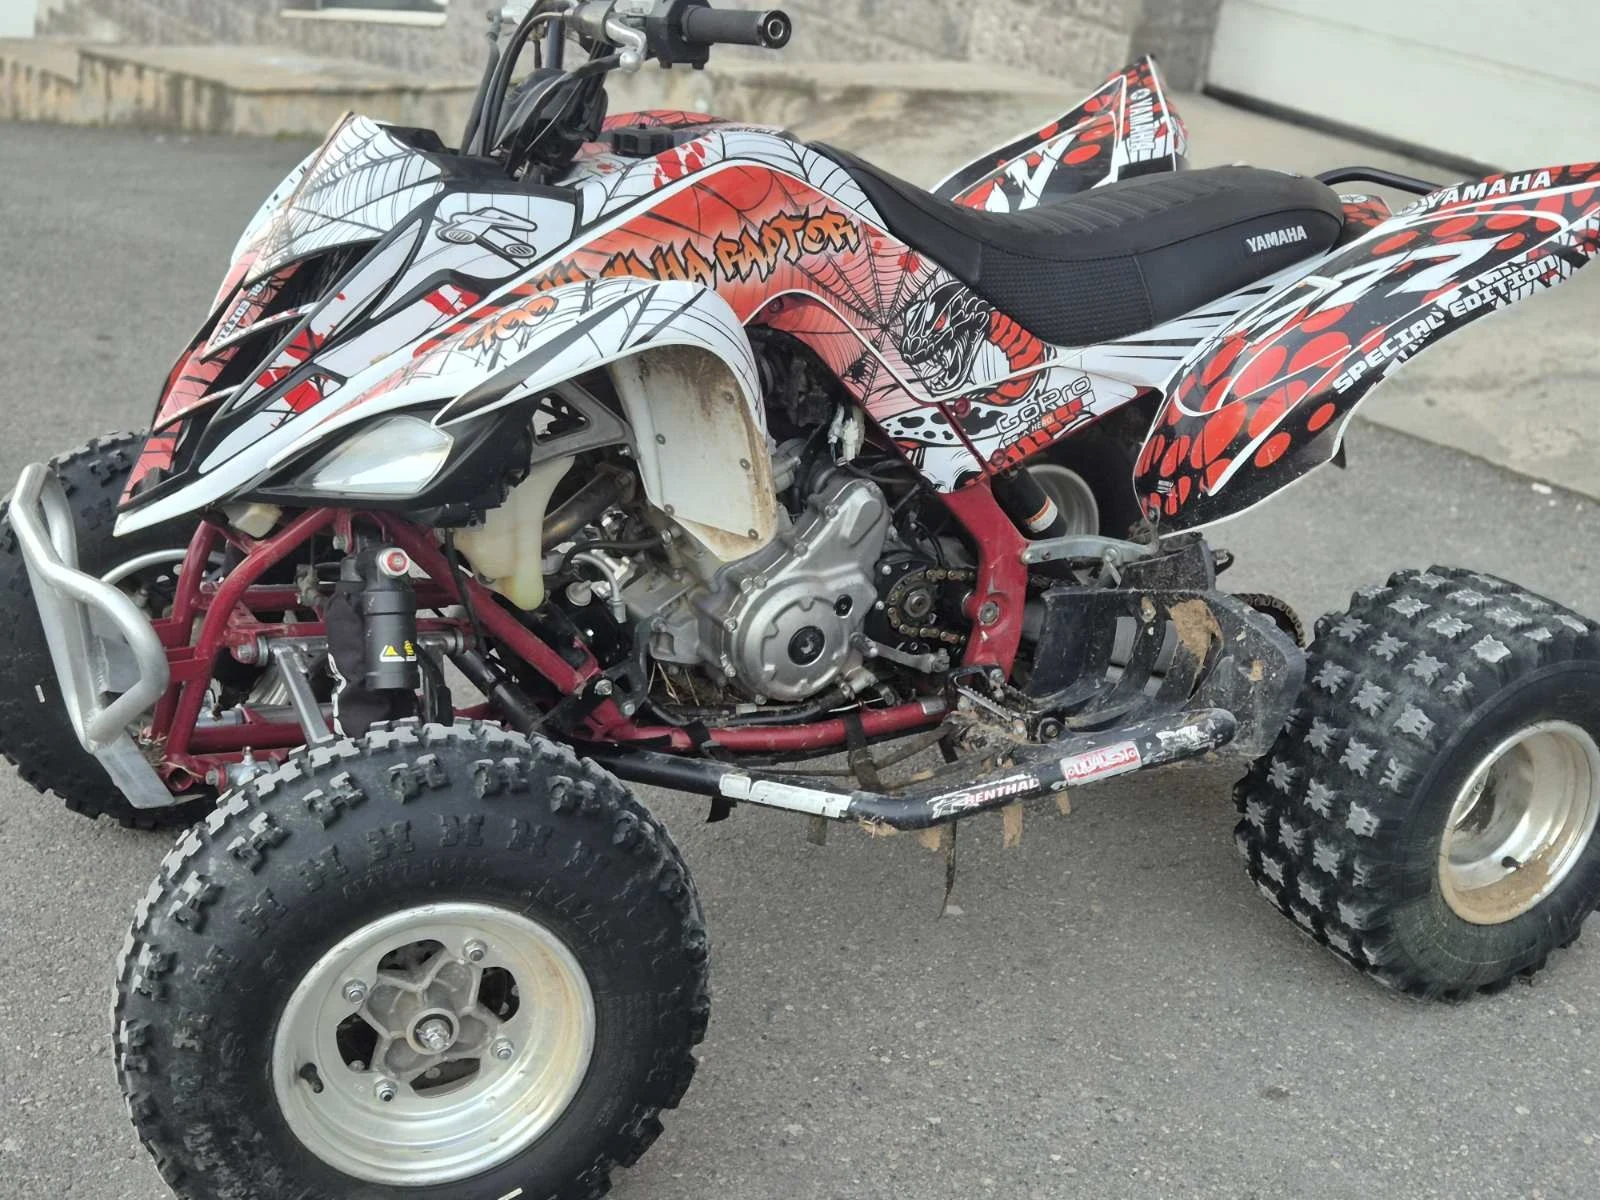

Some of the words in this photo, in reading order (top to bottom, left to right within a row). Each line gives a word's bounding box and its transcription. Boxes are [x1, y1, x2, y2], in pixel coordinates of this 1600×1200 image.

[1425, 171, 1551, 208] YAMAHA
[713, 206, 860, 283] RAPTOR
[1246, 225, 1307, 252] YAMAHA
[1333, 312, 1445, 394] SPECIAL
[1449, 255, 1559, 318] EDITION
[996, 376, 1091, 433] GoPro
